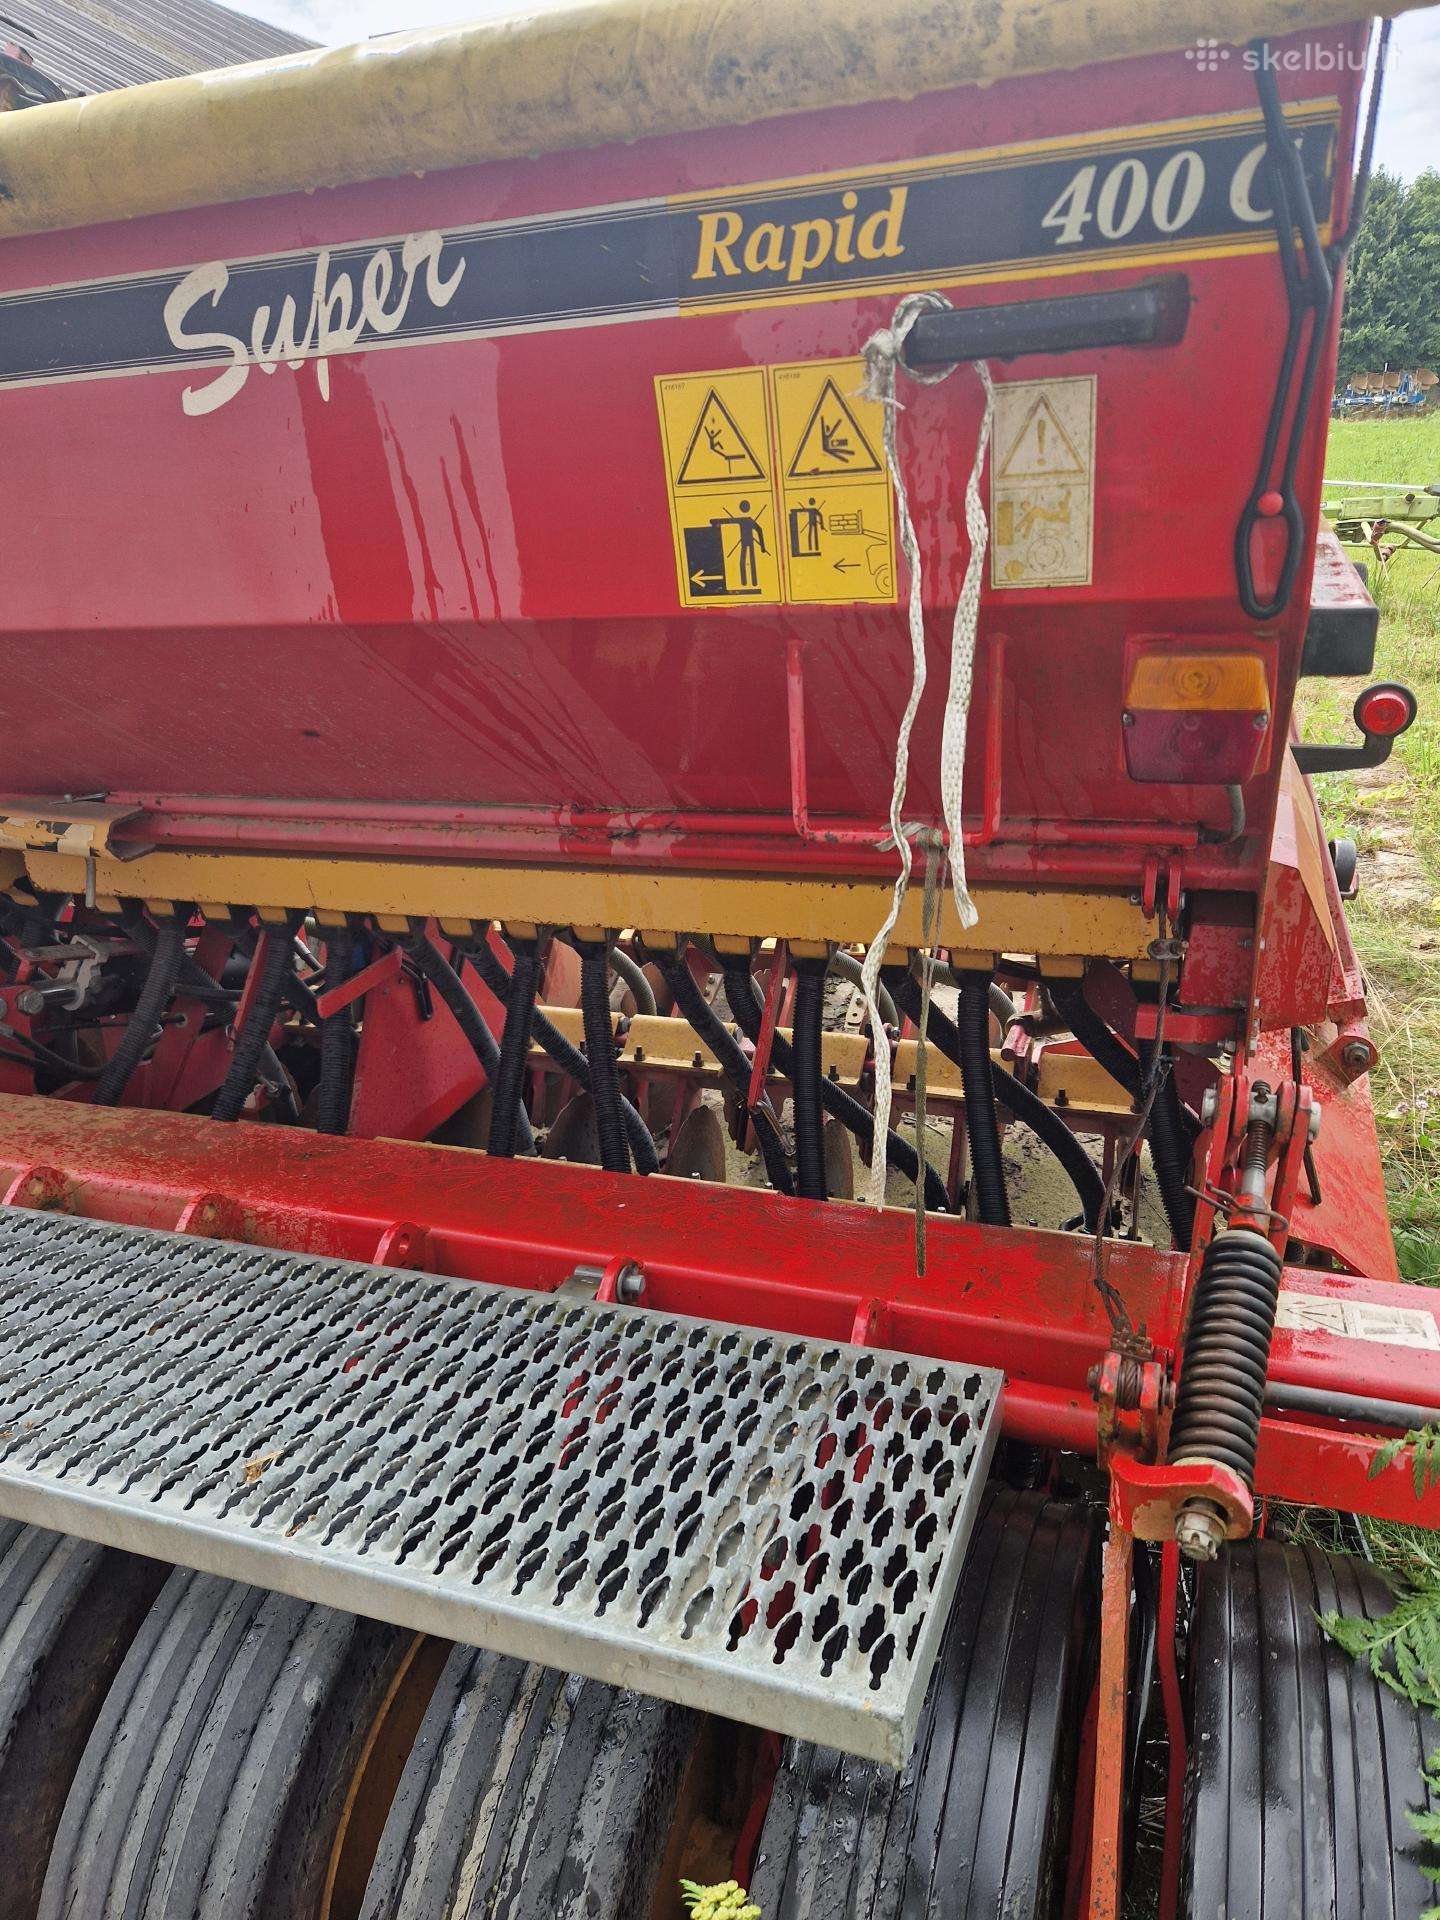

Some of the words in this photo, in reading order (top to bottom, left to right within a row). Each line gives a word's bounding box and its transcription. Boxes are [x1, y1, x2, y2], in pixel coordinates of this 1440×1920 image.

[163, 230, 466, 416] Super
[691, 186, 908, 282] Rapid
[1041, 150, 1205, 244] 400
